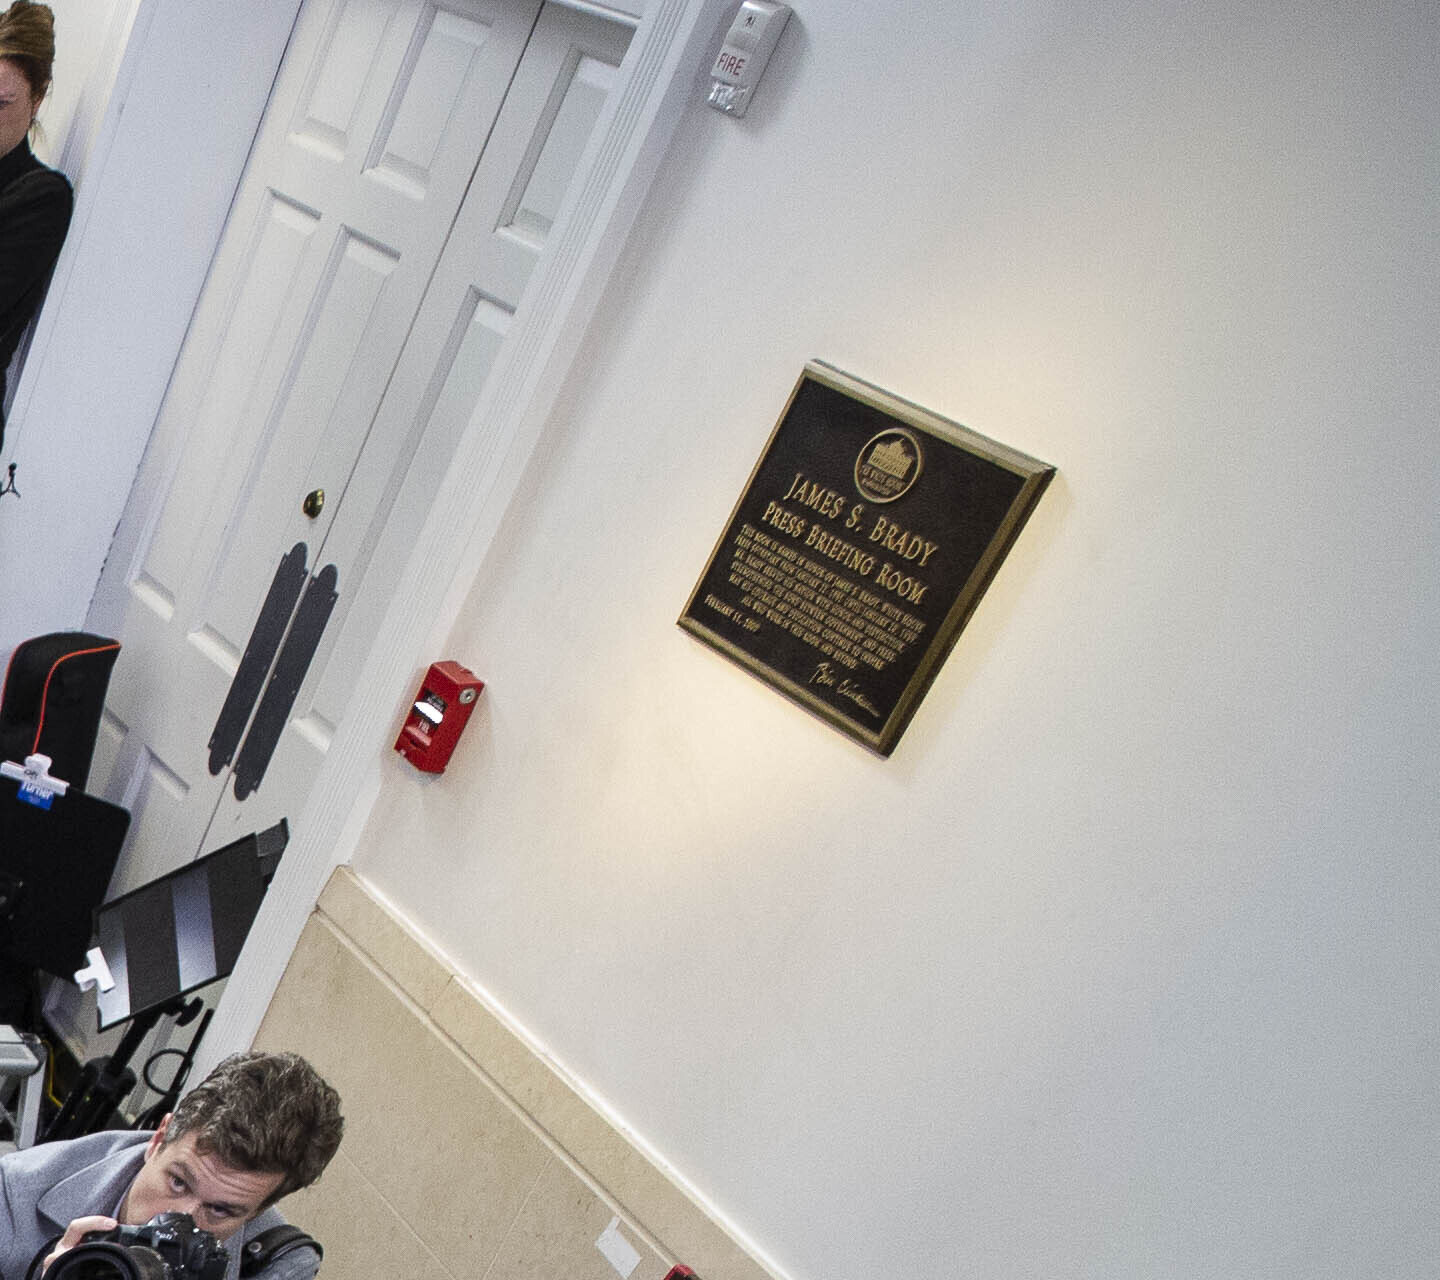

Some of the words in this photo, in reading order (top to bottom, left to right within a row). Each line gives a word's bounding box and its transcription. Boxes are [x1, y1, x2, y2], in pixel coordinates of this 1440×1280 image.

[717, 52, 745, 76] FIRE
[761, 501, 808, 538] PRESS
[804, 524, 877, 577] BRIEFING
[875, 562, 928, 606] ROOM
[783, 472, 848, 520] JAMES
[846, 503, 864, 532] S.
[868, 515, 938, 568] BRADY
